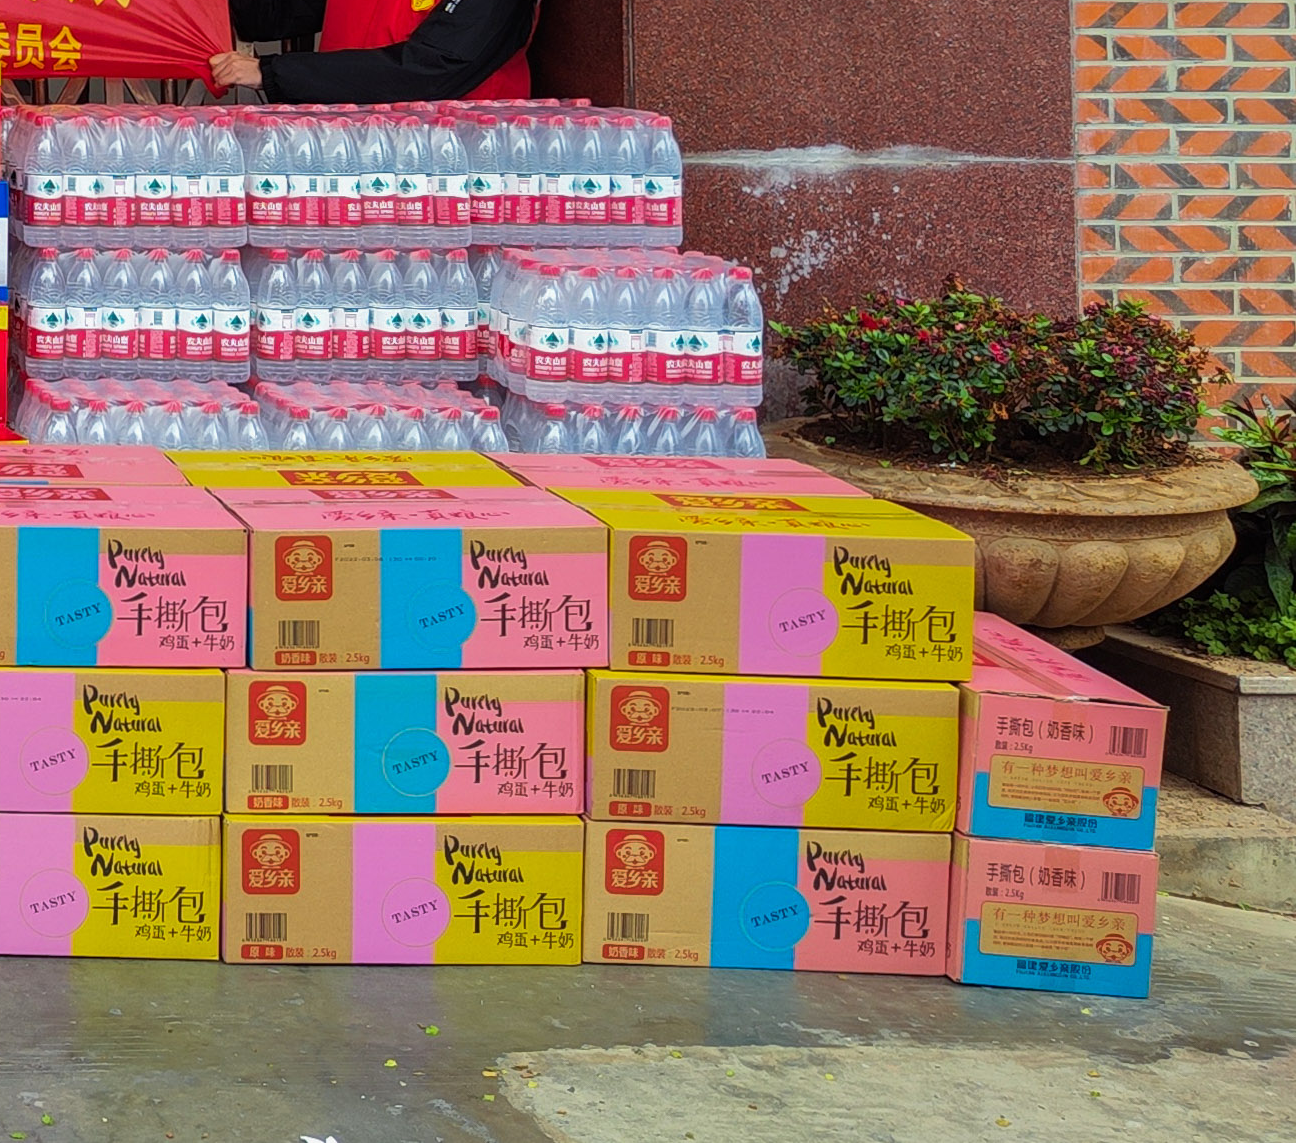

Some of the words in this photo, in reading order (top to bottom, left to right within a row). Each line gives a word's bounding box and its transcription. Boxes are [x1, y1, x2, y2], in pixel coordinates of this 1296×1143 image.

[107, 539, 164, 569] Purely
[471, 539, 527, 570] Purely
[833, 545, 891, 577] Purely
[115, 564, 187, 588] Natural
[280, 575, 327, 595] 爱乡亲
[478, 564, 549, 589] Natural
[634, 575, 681, 595] 爱乡亲
[841, 571, 913, 595] Natural
[55, 602, 102, 627] TASTY
[117, 592, 229, 636] 手撕包
[419, 603, 466, 629] TASTY
[480, 592, 593, 637] 手撕包
[779, 610, 826, 632] TASTY
[842, 600, 956, 645] 手撕包
[159, 635, 235, 651] 鸡蛋+牛奶
[523, 634, 600, 650] 鸡蛋+牛奶
[885, 644, 963, 662] 鸡蛋+牛奶
[345, 652, 370, 665] 2.5kg
[700, 654, 725, 668] 2.5kg
[83, 684, 140, 715] Purely
[445, 686, 502, 716] Purely
[90, 710, 162, 734] Natural
[452, 712, 524, 735] Natural
[817, 697, 875, 728] Purely
[254, 720, 301, 740] 爱乡亲
[616, 725, 663, 745] 爱乡亲
[824, 723, 897, 747] Natural
[29, 748, 76, 773] TASTY
[92, 738, 204, 783] 手撕包
[392, 750, 439, 775] TASTY
[454, 739, 567, 783] 手撕包
[762, 761, 809, 783] TASTY
[1002, 760, 1132, 784] 有一种梦想叫爱乡亲
[825, 752, 939, 797] 手撕包
[134, 781, 211, 798] 鸡蛋+牛奶
[497, 781, 574, 798] 鸡蛋+牛奶
[319, 796, 343, 809] 2.5kg
[682, 806, 706, 818] 2.5kg
[867, 795, 946, 814] 鸡蛋+牛奶
[83, 826, 140, 858] Purely
[444, 834, 501, 865] Purely
[91, 853, 163, 877] Natural
[806, 841, 864, 872] Purely
[248, 869, 294, 889] 爱乡亲
[452, 861, 524, 885] Natural
[611, 869, 659, 889] 爱乡亲
[814, 867, 887, 891] Natural
[29, 890, 77, 915] TASTY
[92, 881, 205, 925] 手撕包
[391, 900, 438, 924] TASTY
[454, 889, 567, 933] 手撕包
[751, 905, 799, 928] TASTY
[815, 895, 929, 939] 手撕包
[992, 907, 1125, 931] 有一种梦想叫爱乡亲
[134, 924, 211, 942] 鸡蛋+牛奶
[497, 931, 574, 950] 鸡蛋+牛奶
[857, 939, 936, 958] 鸡蛋+牛奶
